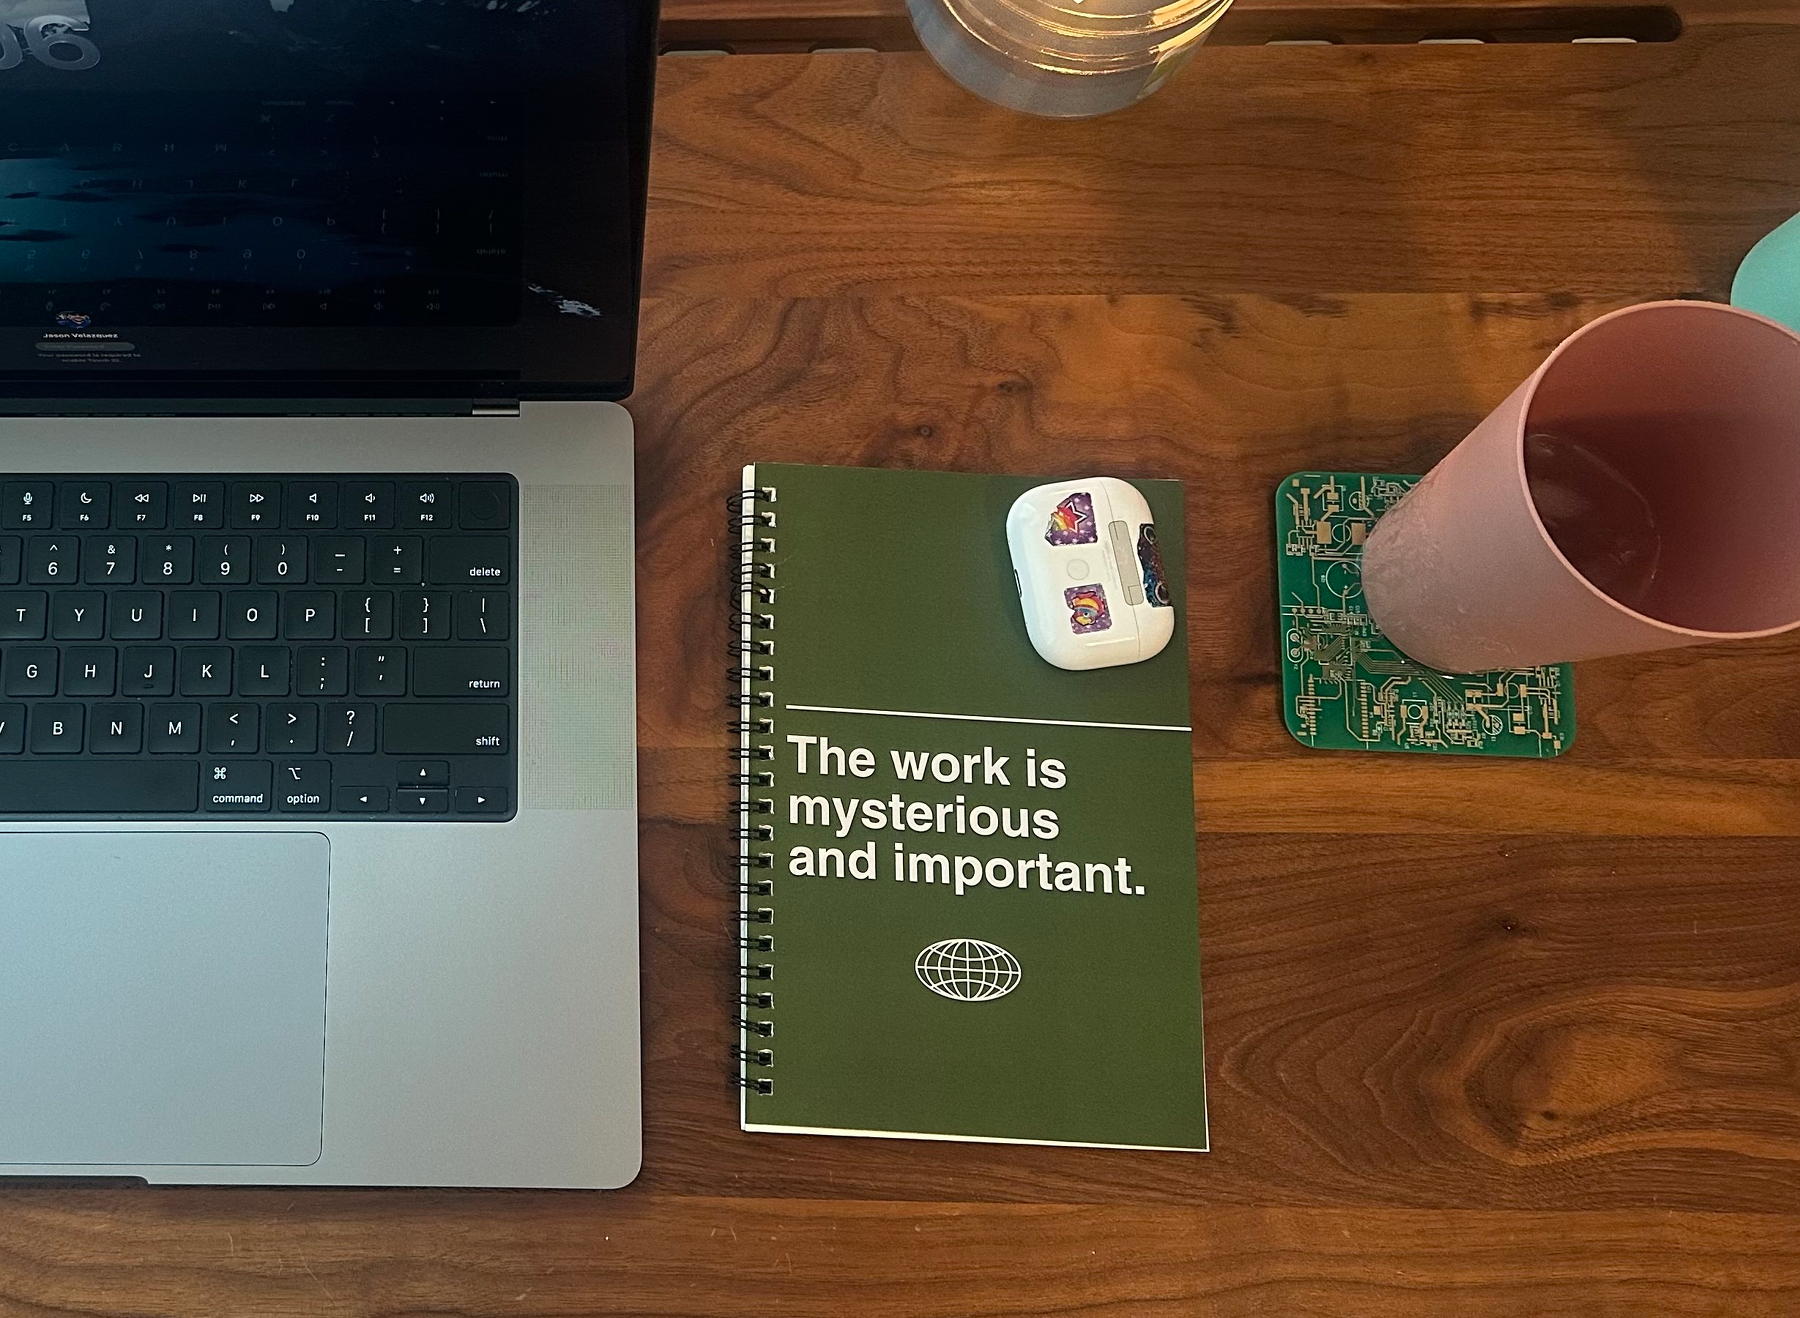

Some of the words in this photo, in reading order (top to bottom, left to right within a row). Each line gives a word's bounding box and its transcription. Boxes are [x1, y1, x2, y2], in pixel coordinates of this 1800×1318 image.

[22, 514, 32, 522] F5
[79, 514, 90, 522] F6
[136, 514, 147, 522] F7
[193, 514, 204, 522] F8
[251, 514, 261, 522] F9
[306, 513, 320, 522] F10
[364, 514, 376, 522] F11
[420, 514, 434, 522] F12
[47, 561, 58, 576] 6
[106, 561, 116, 576] 7
[162, 561, 173, 576] 8
[220, 561, 231, 576] 9
[277, 561, 288, 576] 0
[469, 566, 501, 577] delete
[15, 608, 27, 622] T
[74, 608, 85, 622] Y
[131, 608, 143, 622] U
[246, 607, 258, 622] O
[305, 608, 316, 622] P
[26, 664, 38, 679] G
[84, 664, 96, 678] H
[143, 664, 153, 678] J
[201, 664, 213, 678] K
[260, 664, 270, 678] L
[468, 679, 501, 689] return
[52, 721, 64, 736] B
[110, 721, 123, 735] N
[168, 721, 182, 735] M
[475, 736, 500, 746] shift
[786, 734, 876, 778] The
[889, 747, 1011, 786] work
[1026, 748, 1067, 789] is
[212, 793, 264, 804] command
[286, 793, 320, 806] option
[789, 793, 1060, 840] mysterious
[788, 841, 877, 880] and
[894, 842, 1146, 896] important.
